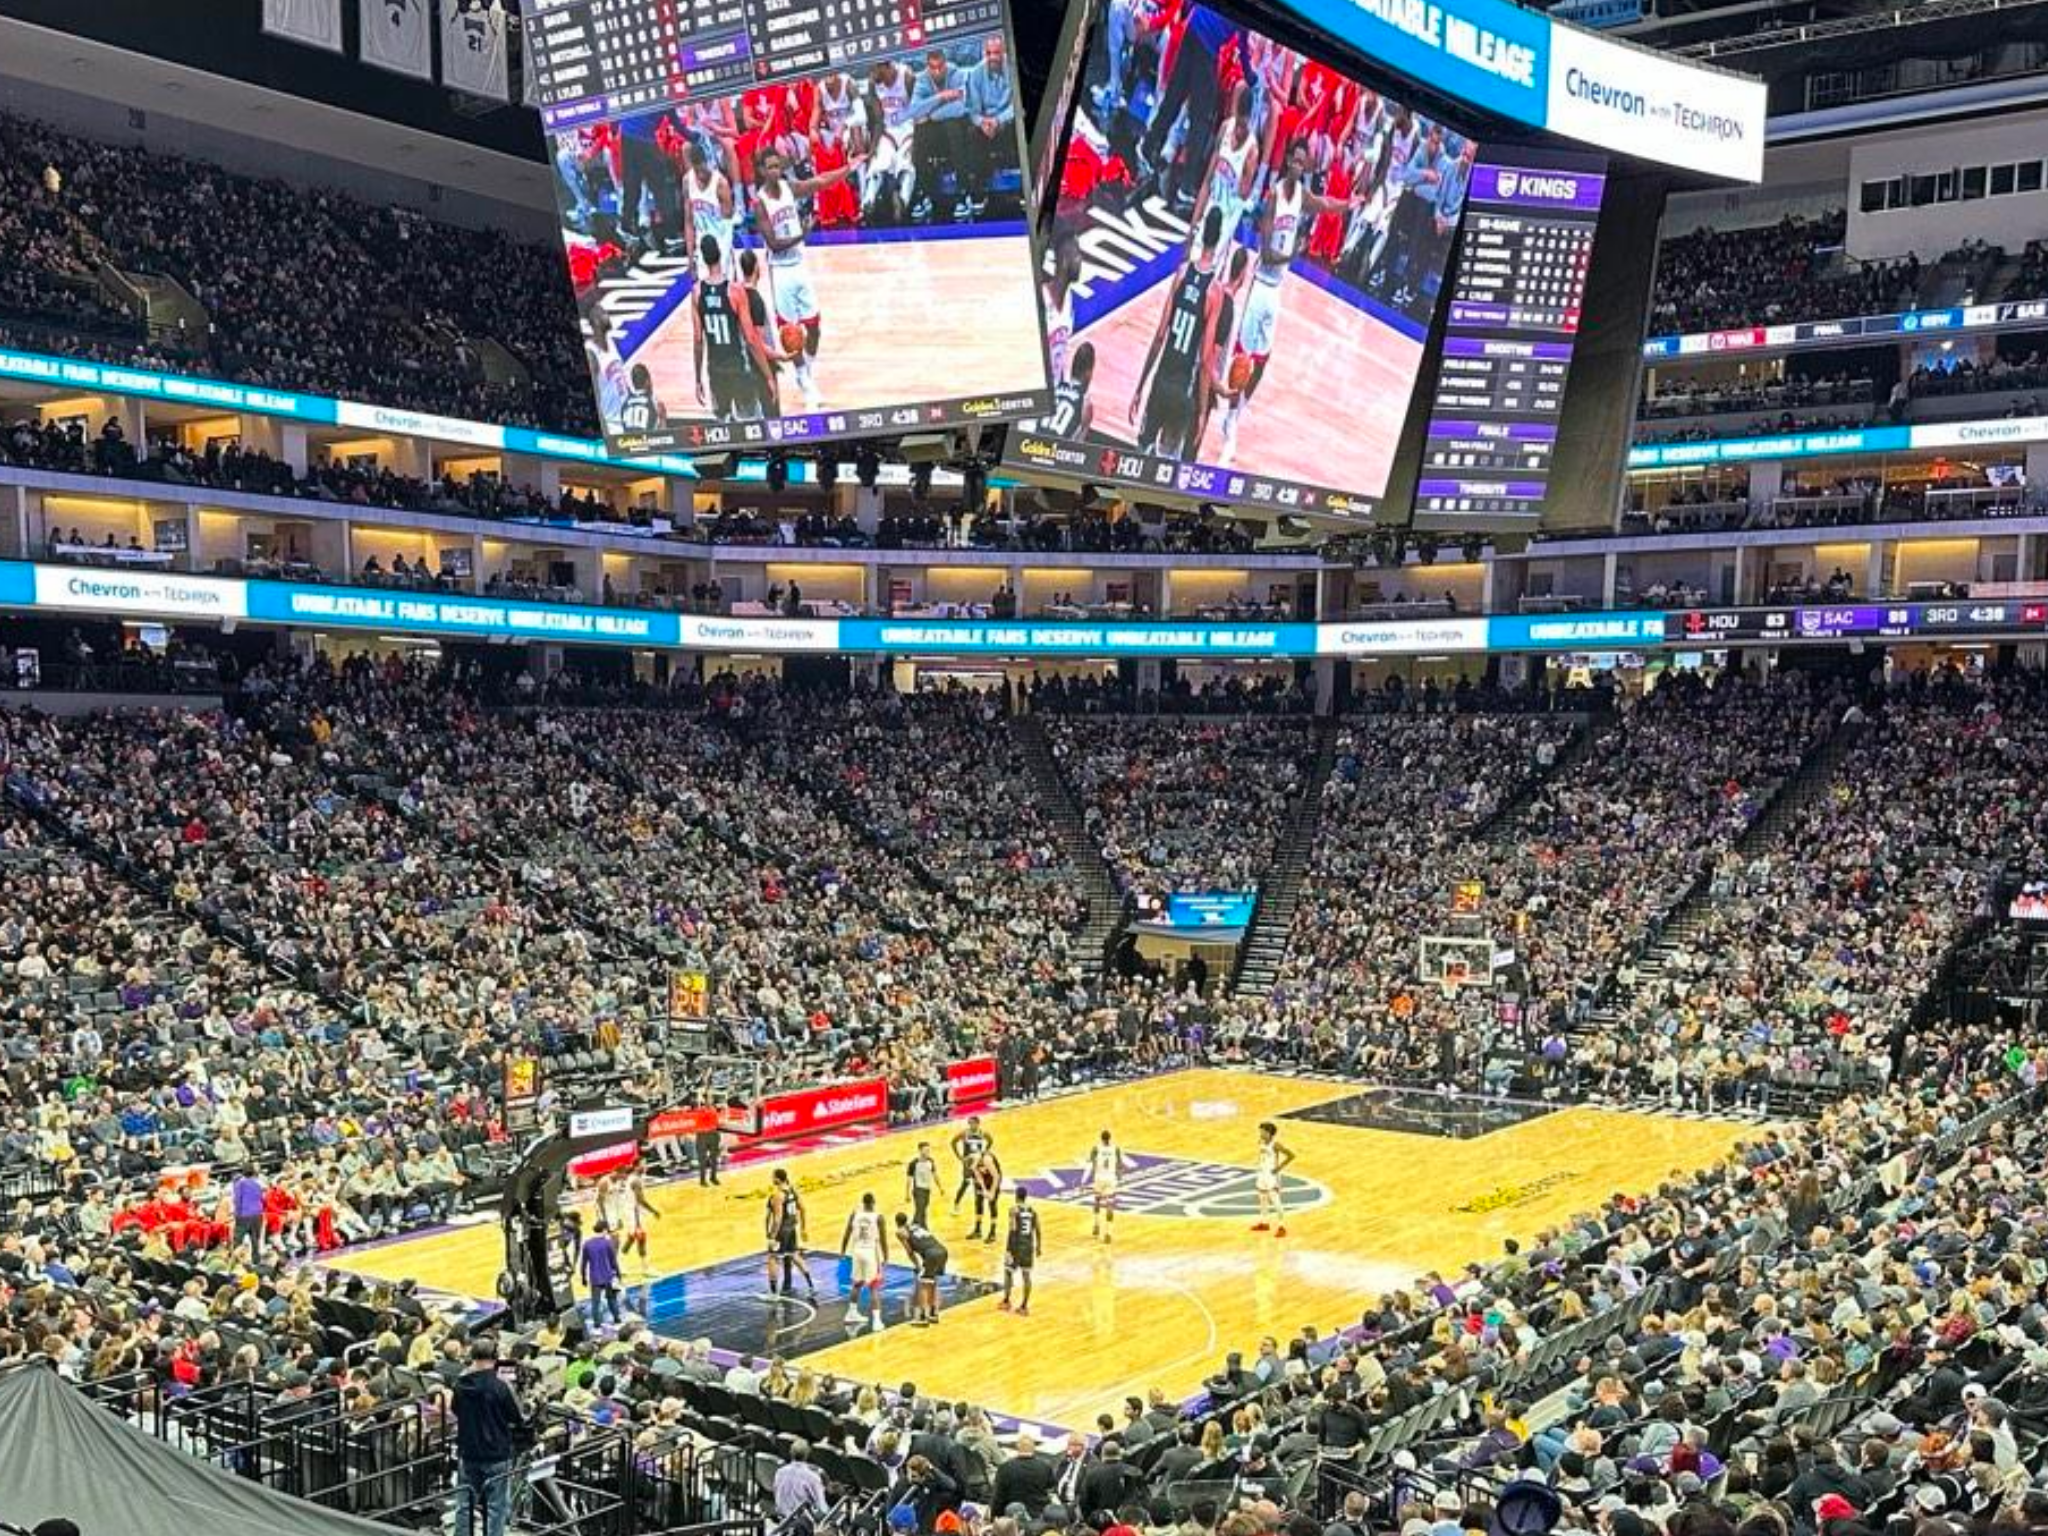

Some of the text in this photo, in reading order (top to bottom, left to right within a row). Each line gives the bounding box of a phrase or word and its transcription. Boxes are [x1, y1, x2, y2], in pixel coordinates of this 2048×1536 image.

[1446, 14, 1536, 88] MILEAGE
[1566, 67, 1645, 117] Chevron
[1519, 175, 1577, 200] KINGS
[704, 314, 731, 345] 41
[1172, 307, 1196, 354] 41
[704, 425, 730, 443] HOU
[784, 420, 808, 436] SAC
[859, 414, 883, 428] 3RD
[1959, 423, 2021, 440] Chevron
[1117, 456, 1143, 478] HOU
[1191, 468, 1215, 490] SAC
[68, 577, 140, 598] Chevron
[399, 600, 437, 621] FANS
[1709, 615, 1739, 629] HOU
[1824, 611, 1854, 625] SAC
[1927, 608, 1958, 623] 3RD
[698, 623, 745, 639] Chevron
[986, 628, 1027, 645] FANS
[1341, 629, 1398, 645] Chevron
